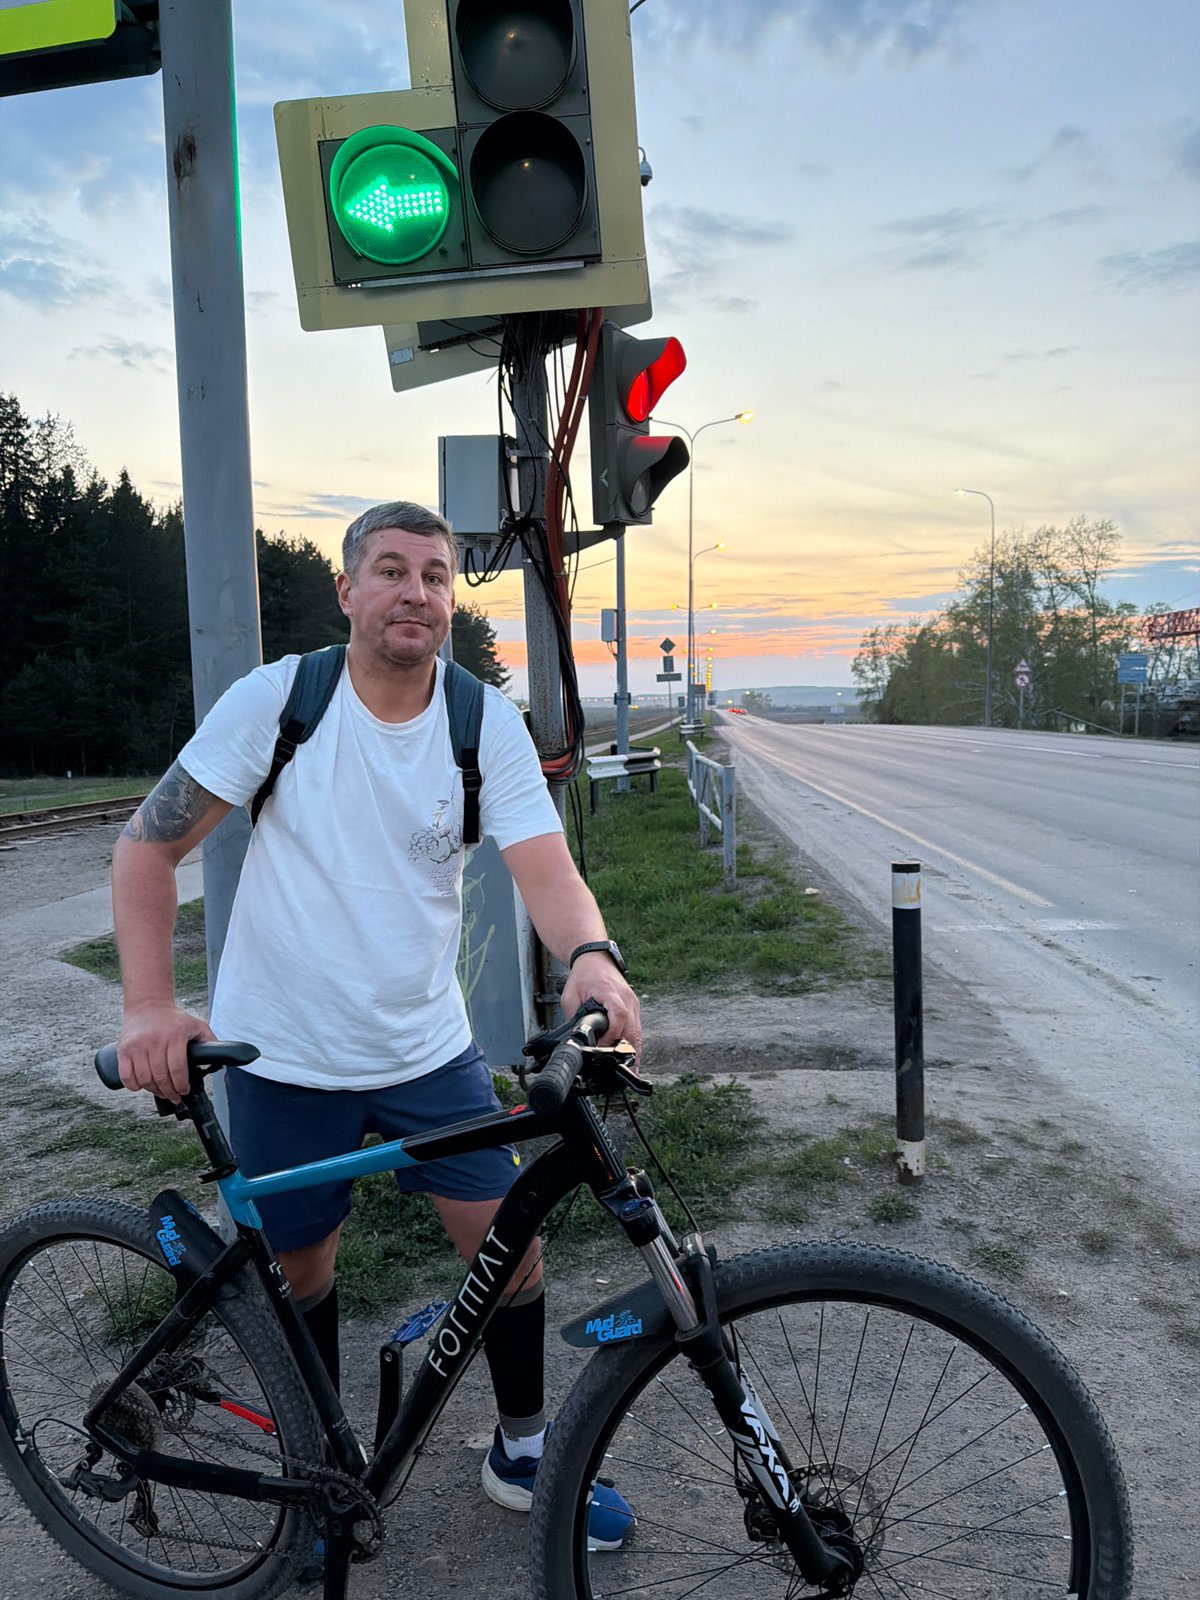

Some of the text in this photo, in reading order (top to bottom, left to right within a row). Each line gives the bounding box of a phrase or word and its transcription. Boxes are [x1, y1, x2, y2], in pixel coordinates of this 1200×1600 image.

[160, 1215, 181, 1242] Mud
[156, 1229, 181, 1266] Guard
[585, 1314, 614, 1335] Mud
[597, 1318, 642, 1342] Guard
